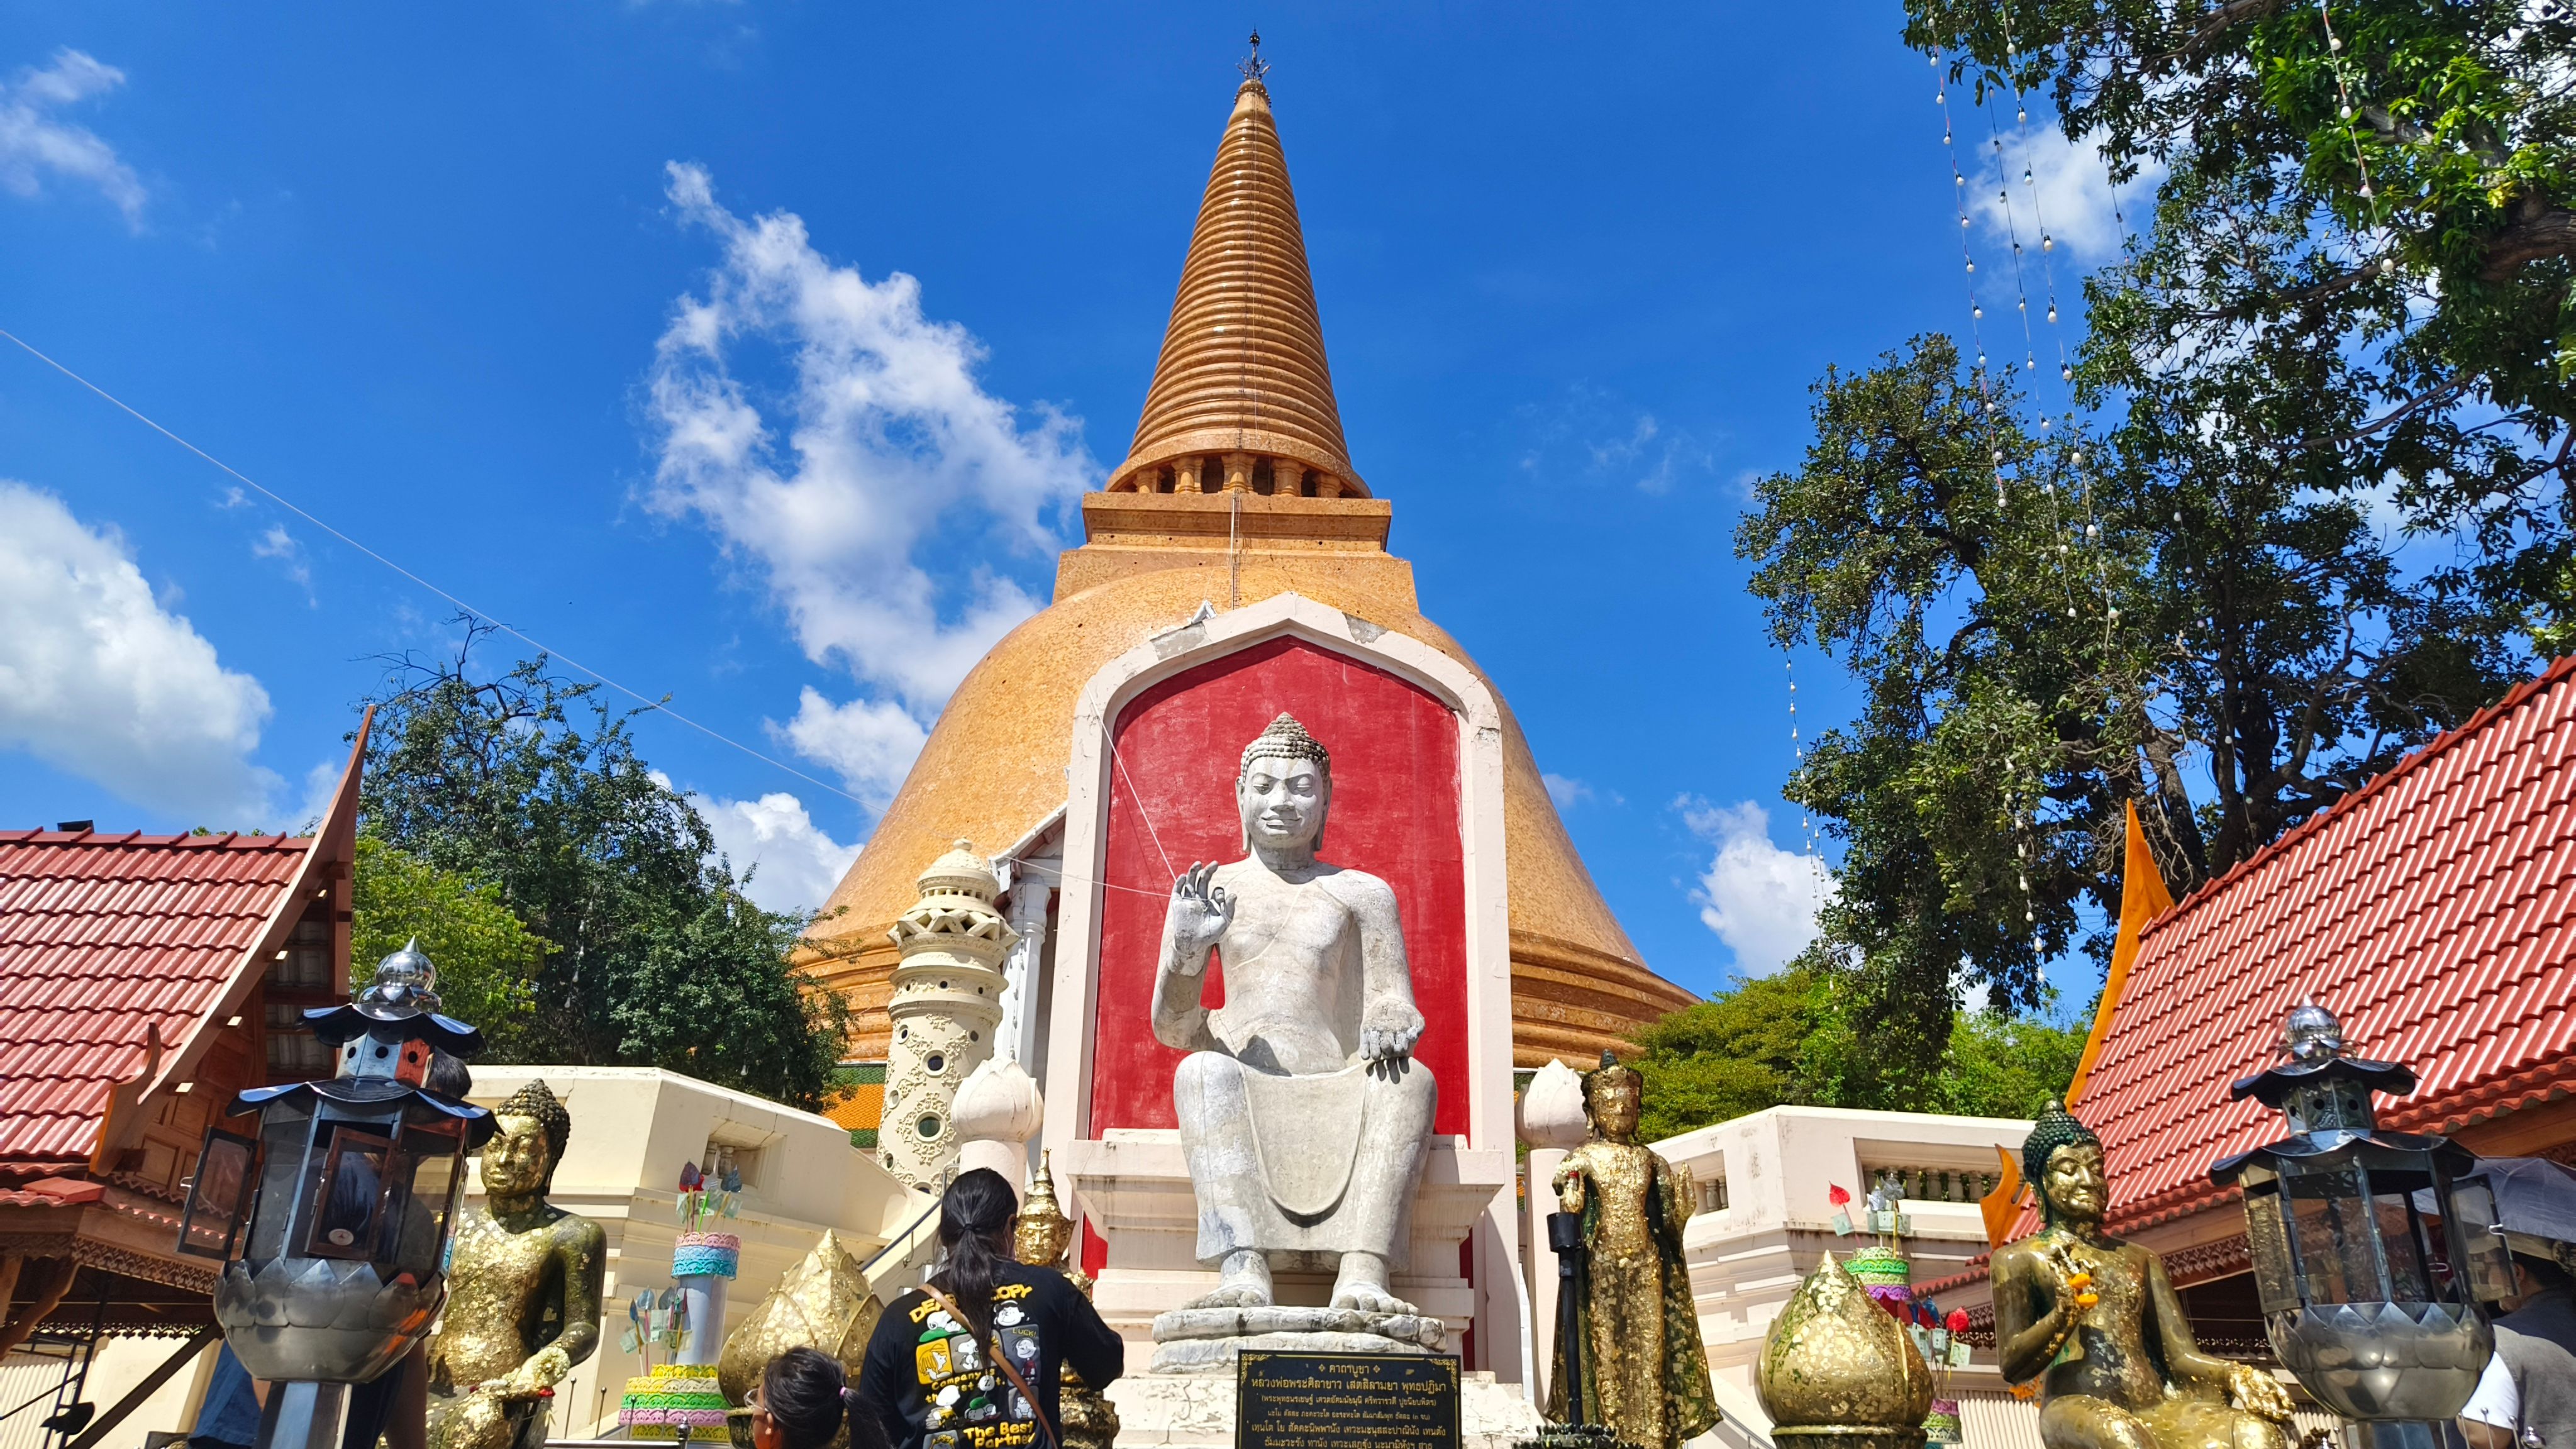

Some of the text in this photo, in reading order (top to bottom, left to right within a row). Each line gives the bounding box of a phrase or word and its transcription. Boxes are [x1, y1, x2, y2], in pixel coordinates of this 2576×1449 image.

[1329, 1364, 1369, 1377] คาถาบูชา
[931, 1371, 982, 1391] Company
[1252, 1375, 1446, 1394] หลวงพ่อพระศิลาขาว เสตสิลามยา พุทธปฏิมา
[963, 1421, 1033, 1440] The Best
